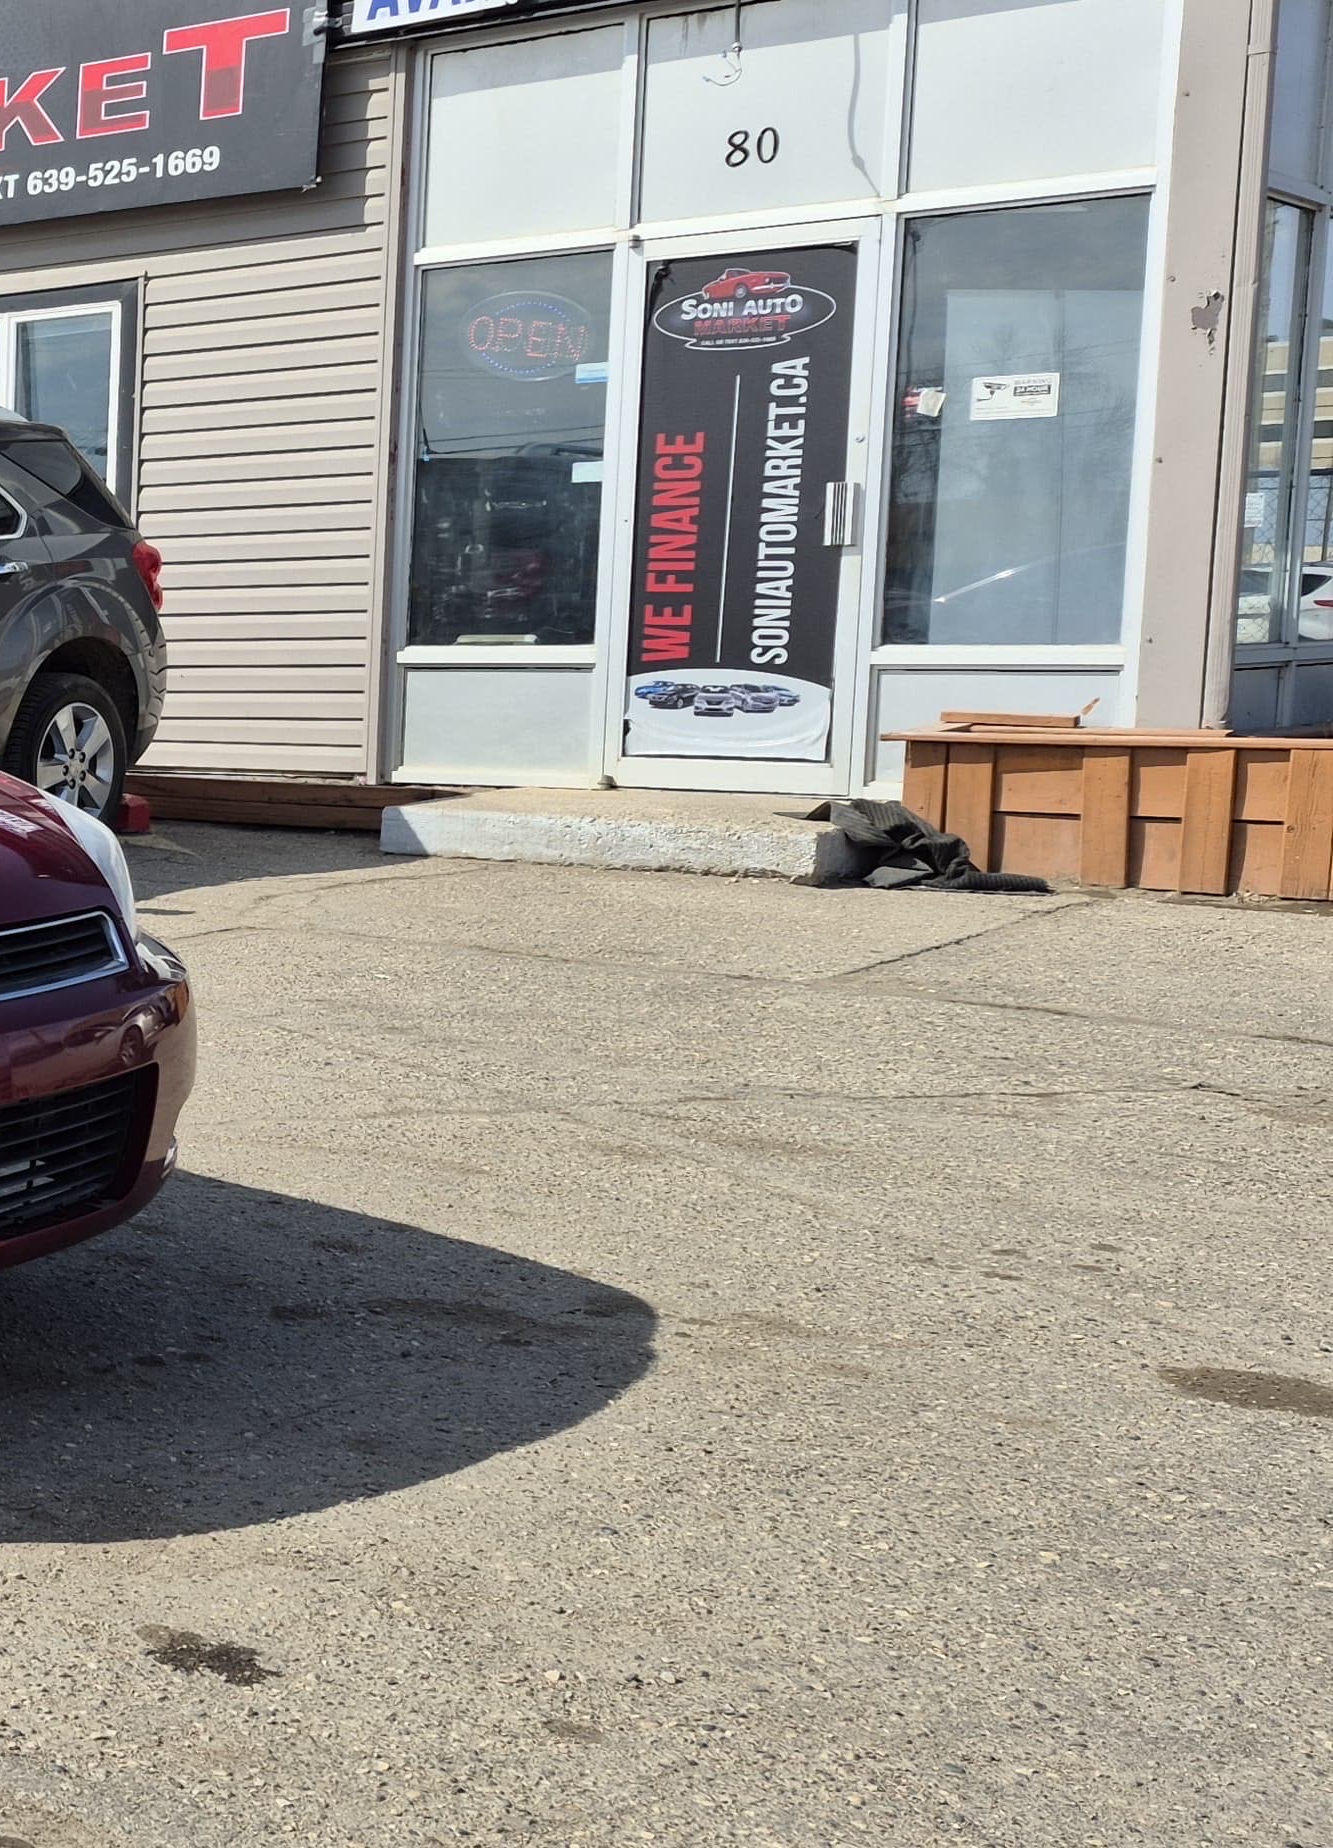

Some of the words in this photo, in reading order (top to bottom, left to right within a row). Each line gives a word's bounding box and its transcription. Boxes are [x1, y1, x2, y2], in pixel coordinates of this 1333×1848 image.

[27, 145, 221, 196] 639-525-1669
[724, 126, 780, 168] 80
[681, 298, 734, 321] SONI
[741, 294, 804, 316] AUTO
[693, 314, 791, 336] MARKET
[468, 315, 588, 361] OPEN
[645, 431, 706, 593] FINANCE
[750, 356, 812, 665] SONIAUTOMARKET.CA
[640, 604, 694, 662] WE
